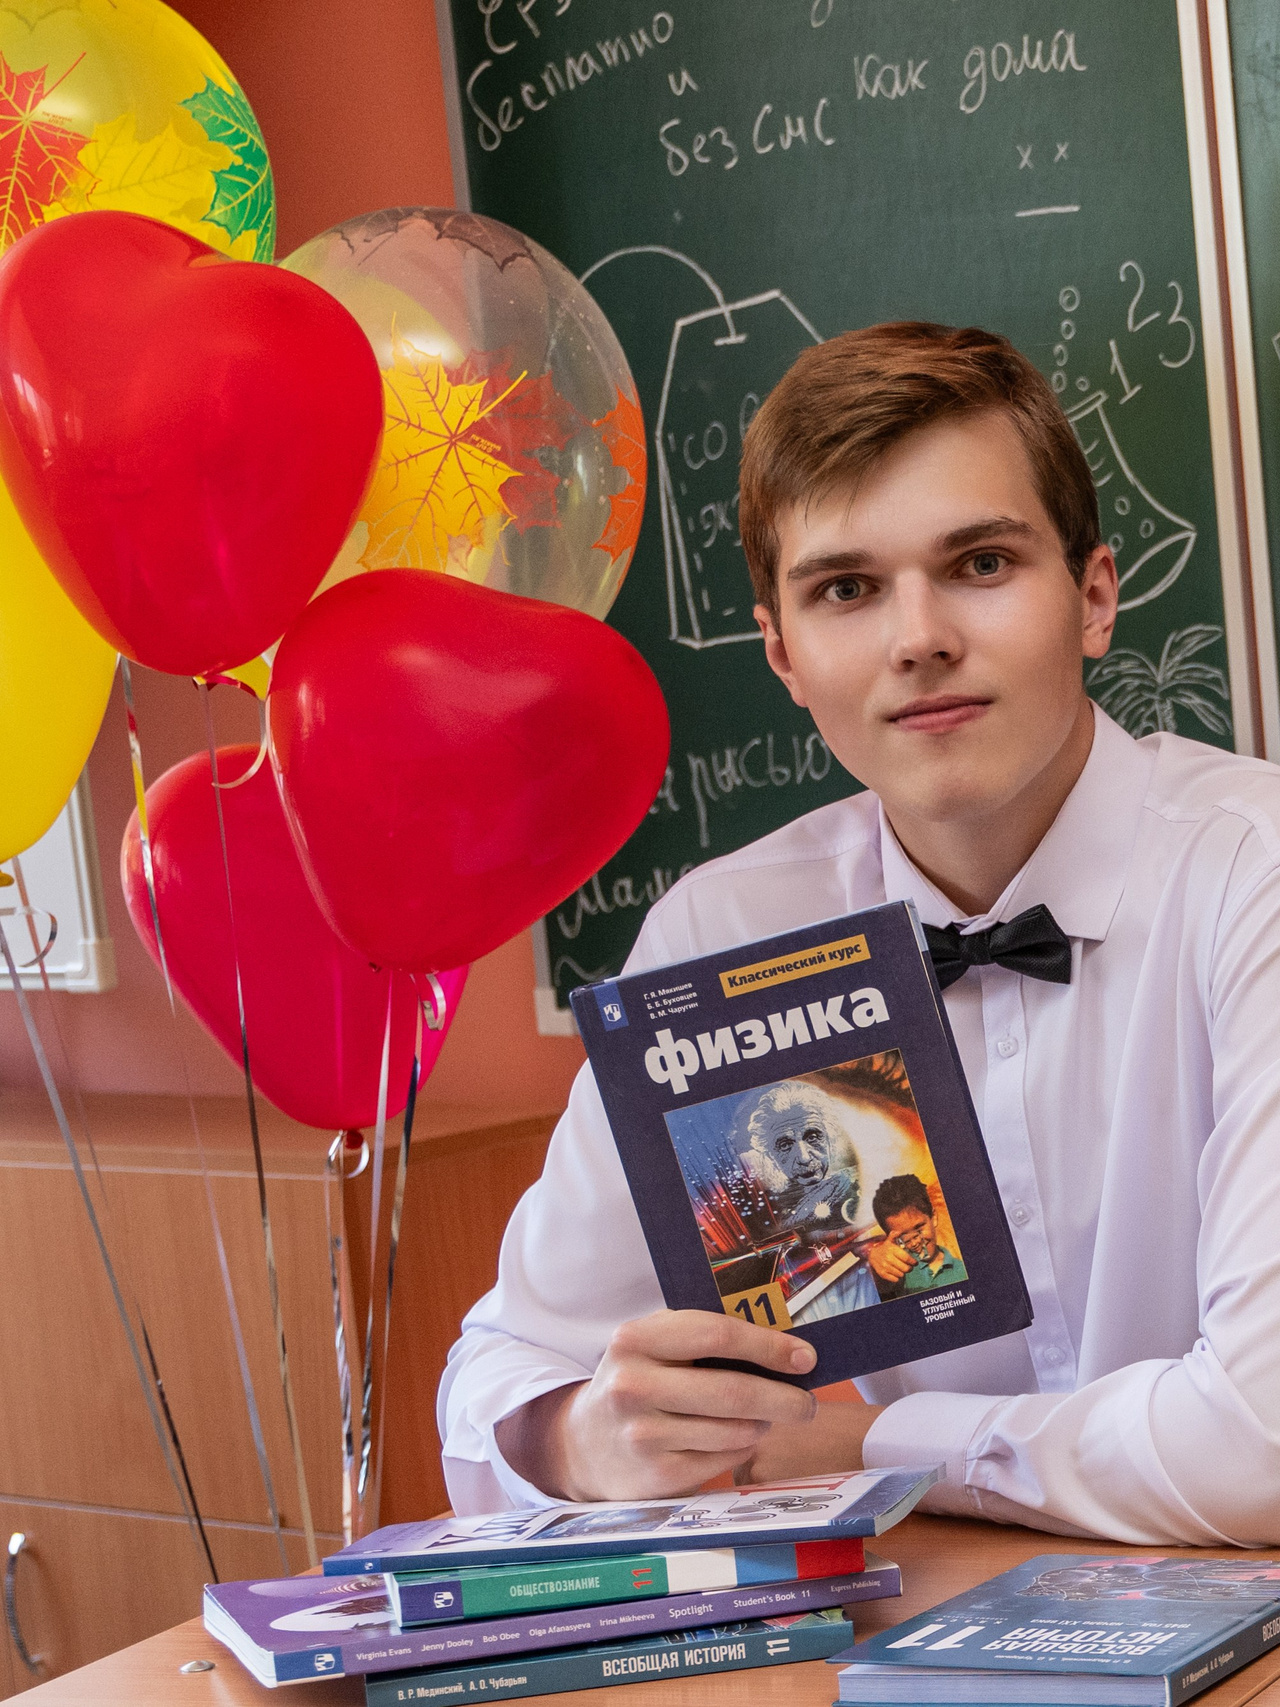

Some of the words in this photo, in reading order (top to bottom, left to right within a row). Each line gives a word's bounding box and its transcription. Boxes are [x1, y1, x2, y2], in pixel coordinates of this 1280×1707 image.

[466, 10, 675, 152] бесплатно
[668, 67, 700, 96] и
[959, 28, 1087, 113] дома
[658, 118, 739, 175] без
[688, 732, 831, 848] рысью
[727, 952, 827, 989] Классический
[828, 942, 863, 963] курс
[657, 982, 693, 997] Мякишев
[662, 991, 697, 1007] Буховцев
[669, 1001, 698, 1016] Чаругин
[644, 987, 890, 1095] физика
[734, 1292, 777, 1327] 11
[919, 1290, 955, 1308] БАЗОВЫЙ
[956, 1289, 962, 1297] И
[925, 1309, 955, 1324] УРОВНИ
[510, 1576, 600, 1598] ОБЩЕСТВОЗНАНИЕ
[631, 1568, 653, 1590] 11
[356, 1649, 387, 1661] Virginia
[388, 1646, 412, 1657] Evans
[421, 1641, 445, 1653] Jenny
[447, 1638, 474, 1650] Dooley
[483, 1635, 498, 1643] Bob
[500, 1632, 520, 1641] Obee
[529, 1627, 546, 1638] Olga
[548, 1621, 591, 1634] Afanasyeva
[600, 1616, 618, 1627] Irina
[619, 1612, 655, 1624] Mikheeva
[669, 1602, 713, 1619] Spotlight
[733, 1594, 773, 1608] Student's
[775, 1591, 796, 1602] Book
[801, 1590, 811, 1598] 11
[831, 1583, 851, 1594] Express
[852, 1578, 881, 1591] Publishing
[885, 1623, 986, 1651] 11
[981, 1640, 1157, 1656] ВСЕОБЩАЯ
[1001, 1627, 1178, 1644] ИСТОРИЯ
[602, 1651, 679, 1678] ВСЕОБЩАЯ
[685, 1641, 746, 1666] ИСТОРИЯ
[766, 1638, 790, 1657] 11
[398, 1690, 405, 1701] В.
[408, 1688, 415, 1700] Р.
[417, 1682, 466, 1699] Мединский,
[469, 1681, 478, 1692] А.
[480, 1679, 488, 1691] О.
[489, 1674, 528, 1689] Чубарьян
